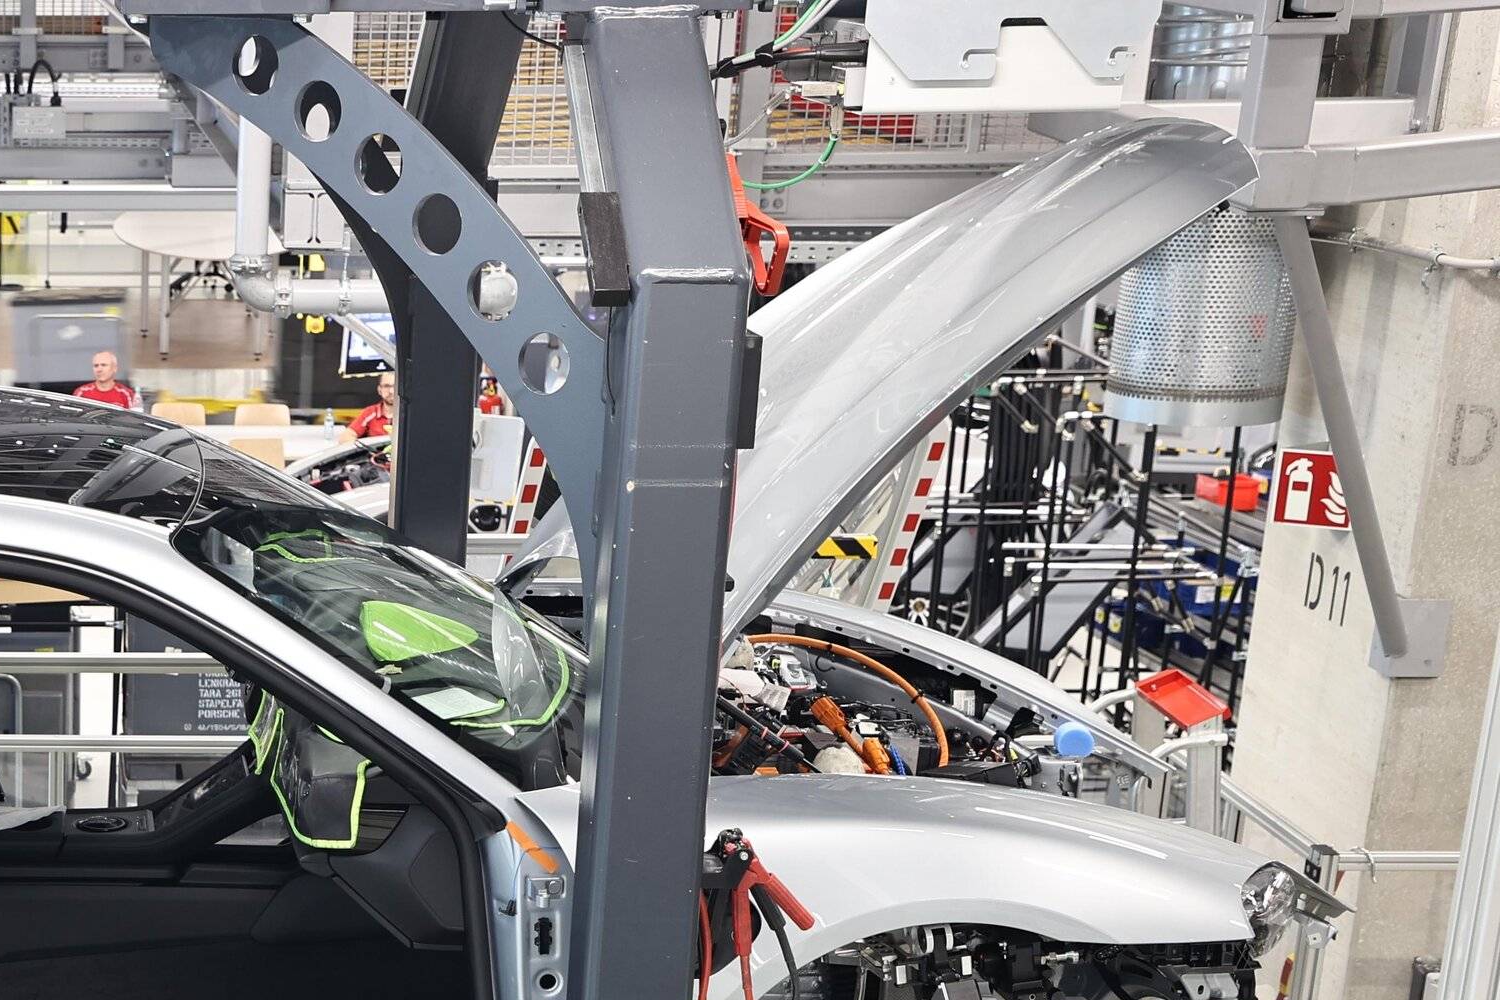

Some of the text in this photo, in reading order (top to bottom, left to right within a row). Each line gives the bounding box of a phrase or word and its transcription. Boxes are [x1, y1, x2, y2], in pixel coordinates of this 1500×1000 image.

[1304, 552, 1351, 627] D 11
[199, 688, 221, 698] TARA
[198, 709, 240, 718] PORSCHE
